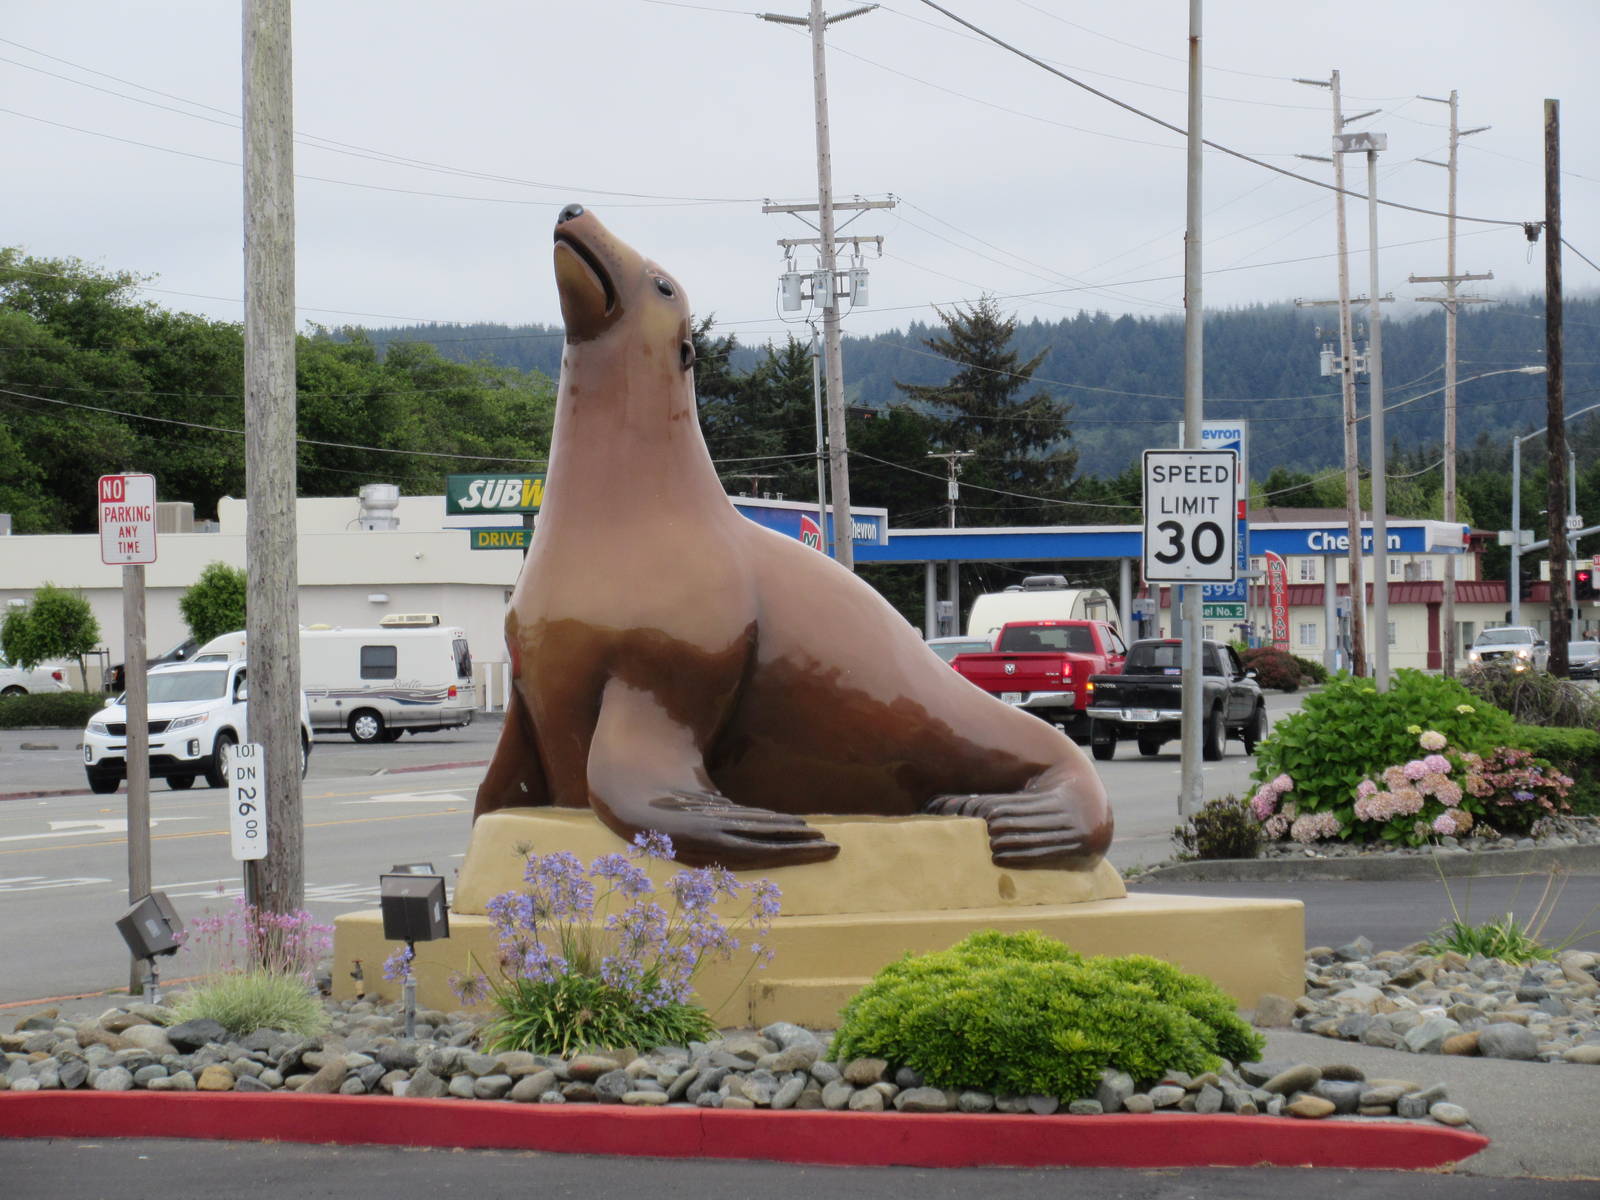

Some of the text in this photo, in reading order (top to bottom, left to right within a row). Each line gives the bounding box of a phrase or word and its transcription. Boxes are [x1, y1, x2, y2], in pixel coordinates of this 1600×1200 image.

[1201, 429, 1240, 440] evron
[1152, 465, 1229, 483] SPEED
[102, 480, 122, 499] NO
[457, 479, 545, 510] SUBW
[1161, 496, 1220, 514] LIMIT
[104, 506, 151, 523] PARKING
[118, 525, 138, 538] ANY
[851, 518, 877, 540] hevron
[118, 541, 140, 553] TIME
[478, 532, 524, 546] DRIVE
[1154, 520, 1225, 565] 30
[1307, 531, 1401, 550] Chern
[1216, 606, 1233, 616] No.
[1236, 606, 1243, 616] 2
[235, 744, 255, 758] 101
[237, 766, 256, 780] DN
[238, 786, 258, 839] 26 00
